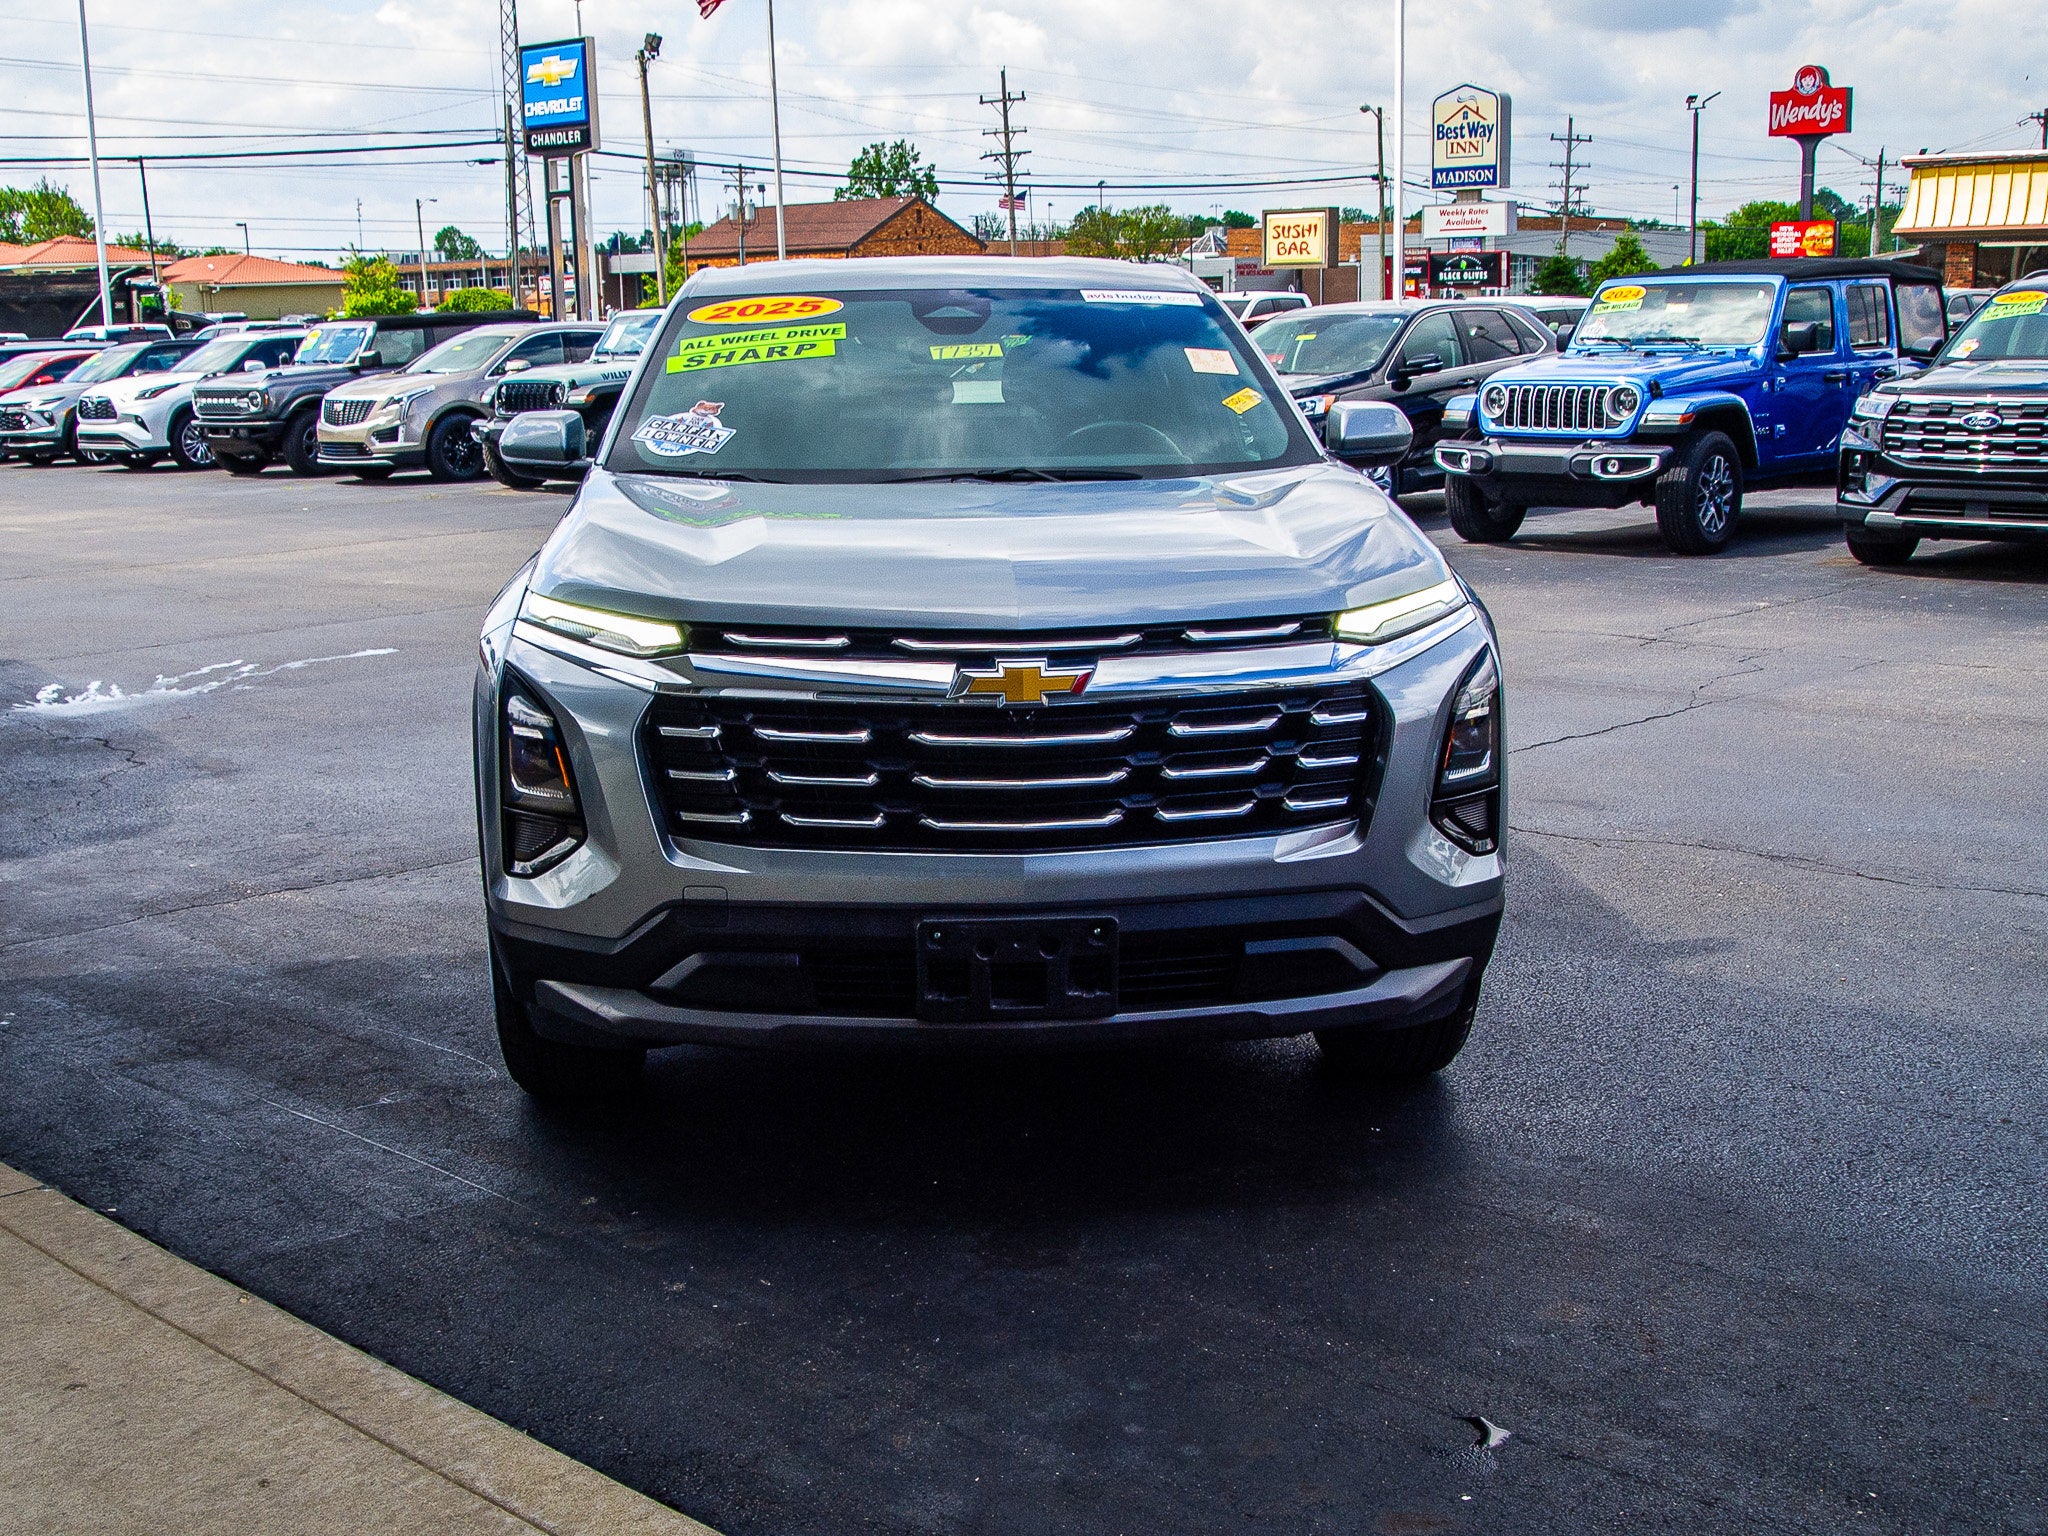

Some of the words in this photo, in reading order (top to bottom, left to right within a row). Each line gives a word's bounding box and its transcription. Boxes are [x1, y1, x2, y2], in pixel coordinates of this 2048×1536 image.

[524, 96, 583, 118] CHEVROLET
[1771, 94, 1843, 130] Wendy's
[531, 130, 581, 147] CHANDLER
[1436, 122, 1466, 140] Best
[1466, 120, 1495, 143] Way
[1449, 141, 1480, 154] INN
[1435, 169, 1494, 184] MADISON
[1440, 209, 1467, 217] Weekly
[1468, 207, 1489, 215] Rates
[1445, 218, 1483, 226] Available
[1272, 223, 1318, 239] SUSHI
[1277, 241, 1311, 256] BAR
[1439, 271, 1461, 281] BLACK
[1463, 270, 1488, 280] OLIVES
[1604, 289, 1642, 300] 2024
[705, 300, 825, 321] 2025
[684, 339, 718, 350] ALL
[721, 332, 781, 346] WHEEL
[786, 327, 843, 339] DRIVE
[683, 343, 818, 368] SHARP
[1967, 416, 1992, 426] Ford
[649, 420, 728, 440] CARFAX
[653, 430, 720, 449] OWNER
